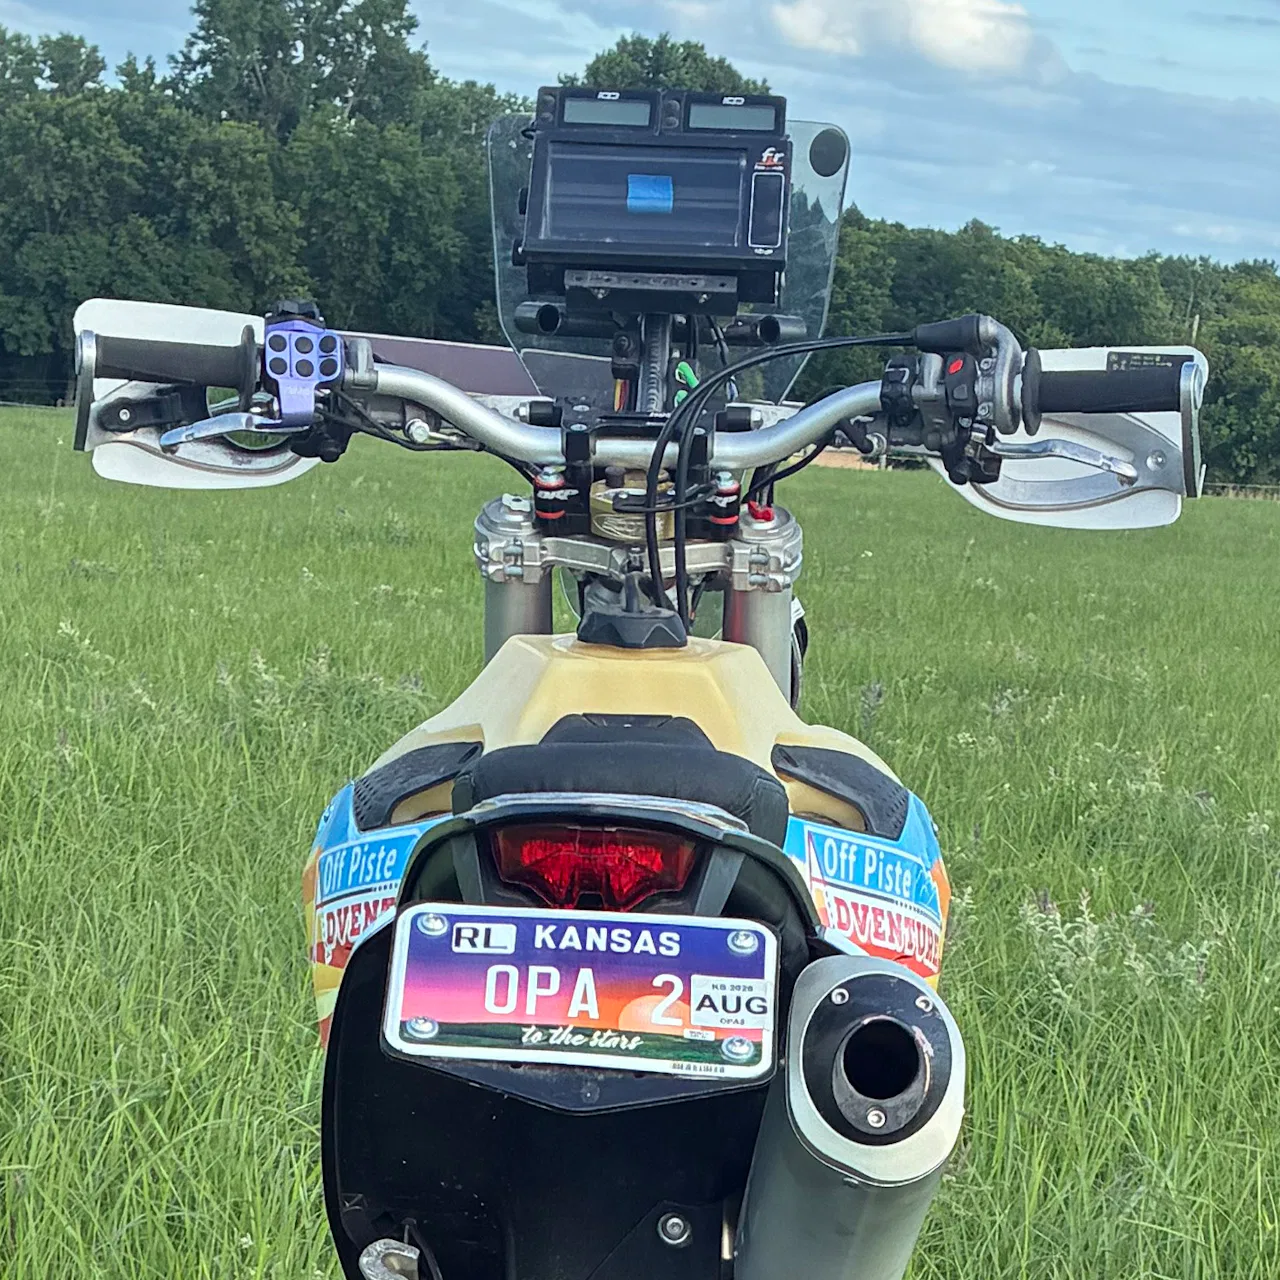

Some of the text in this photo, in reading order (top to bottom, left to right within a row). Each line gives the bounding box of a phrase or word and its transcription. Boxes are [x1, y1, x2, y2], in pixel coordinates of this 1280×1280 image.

[323, 843, 397, 894] Off Piste
[823, 837, 912, 898] Off Piste
[454, 926, 508, 949] RL
[534, 924, 681, 957] KANSAS
[484, 964, 684, 1026] OPA 2
[695, 994, 768, 1015] AUG
[521, 1024, 644, 1051] to the stars
